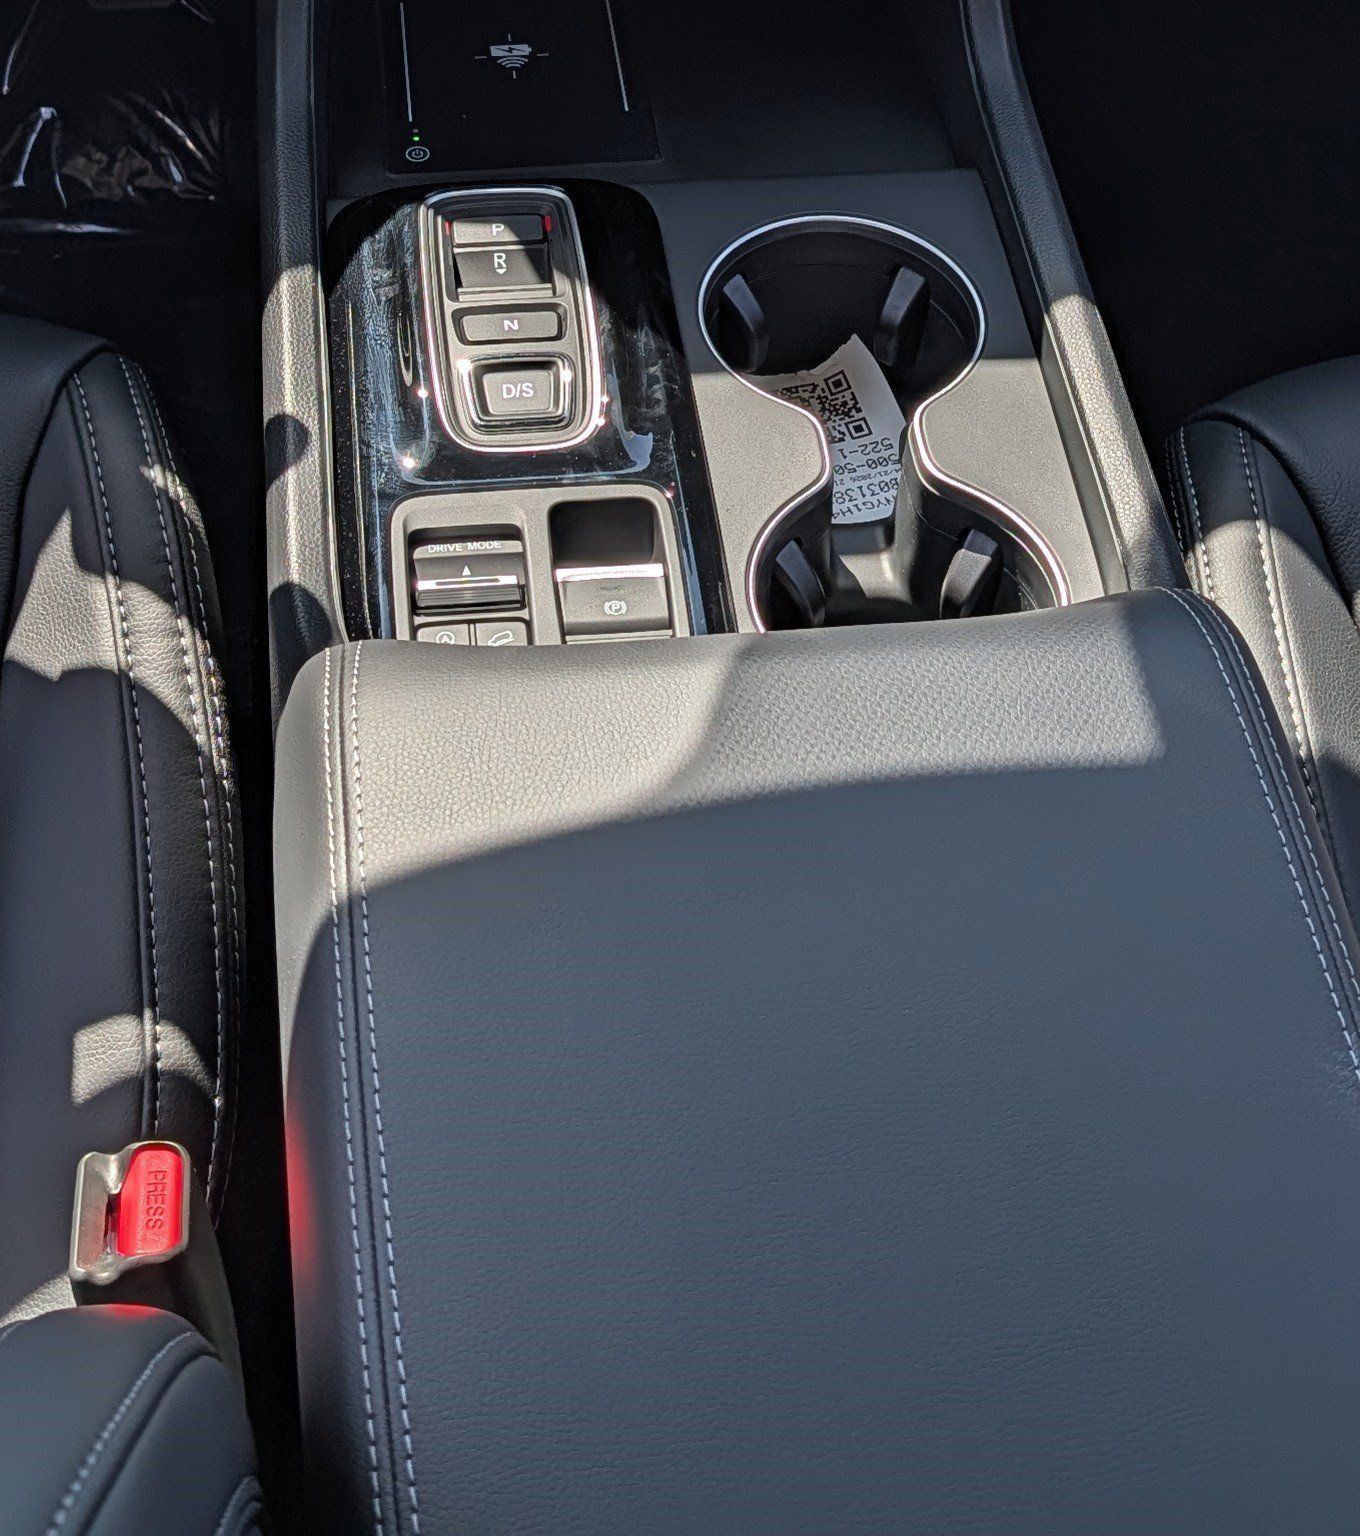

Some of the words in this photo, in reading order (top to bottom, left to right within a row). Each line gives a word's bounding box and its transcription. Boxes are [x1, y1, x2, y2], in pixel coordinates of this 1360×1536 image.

[492, 223, 505, 236] P
[494, 252, 506, 268] R
[503, 319, 519, 331] N
[501, 383, 534, 399] D/S
[838, 437, 894, 460] 522-1
[427, 542, 463, 554] DRIVE
[467, 540, 502, 551] MODE
[145, 1169, 168, 1230] PRESS
